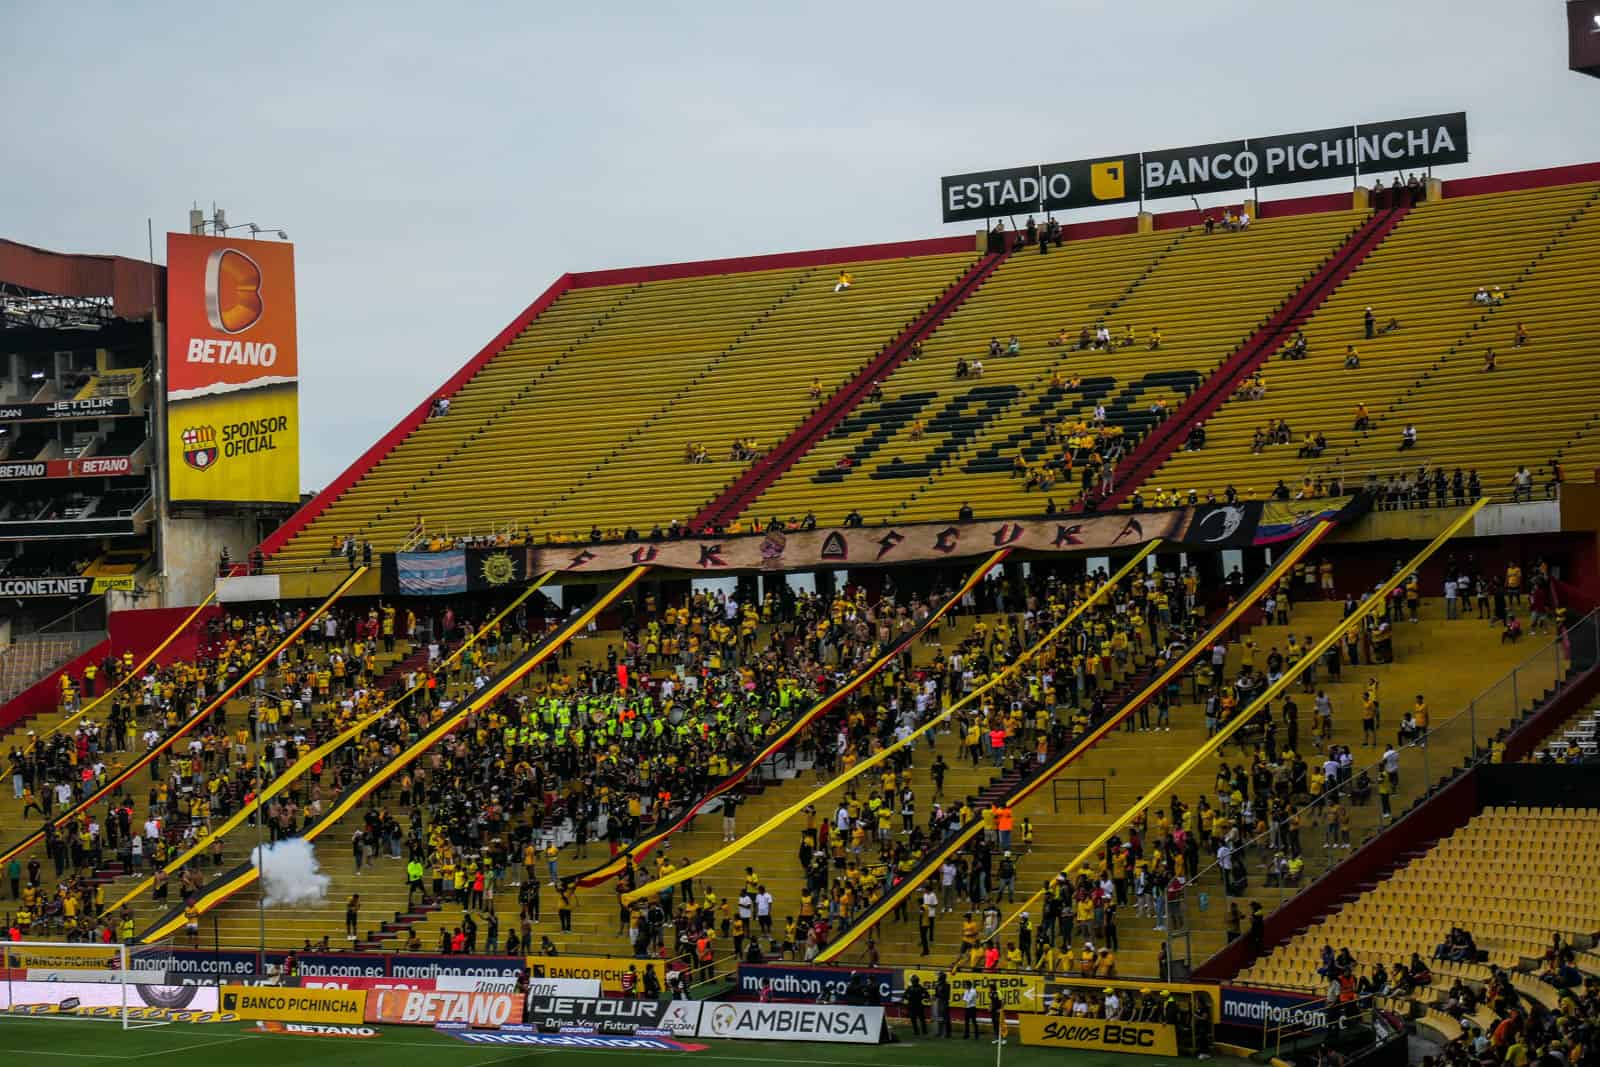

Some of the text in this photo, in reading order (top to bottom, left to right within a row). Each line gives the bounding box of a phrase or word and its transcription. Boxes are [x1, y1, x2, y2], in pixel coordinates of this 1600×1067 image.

[949, 125, 1456, 211] ESTADIO BANCO PICHINCHA
[187, 338, 277, 367] BETANO
[46, 398, 114, 411] JETOUR
[222, 415, 287, 442] SPONSOR
[224, 434, 277, 458] OFICIAL
[0, 463, 45, 478] BETANO
[82, 458, 128, 473] BETANO
[134, 956, 254, 974] marathon.com.ec
[743, 972, 890, 996] mrathoncoc
[241, 996, 358, 1013] BANCO PICHINCHA
[402, 992, 513, 1025] BETANO
[534, 999, 658, 1017] JETOUR
[1224, 999, 1347, 1029] marathon.com.c
[286, 1024, 376, 1036] BETANO
[545, 1018, 640, 1031] Drive Your Future
[736, 1009, 869, 1035] AMBIENSA
[462, 1031, 669, 1049] marathon
[1103, 1024, 1155, 1047] BSC
